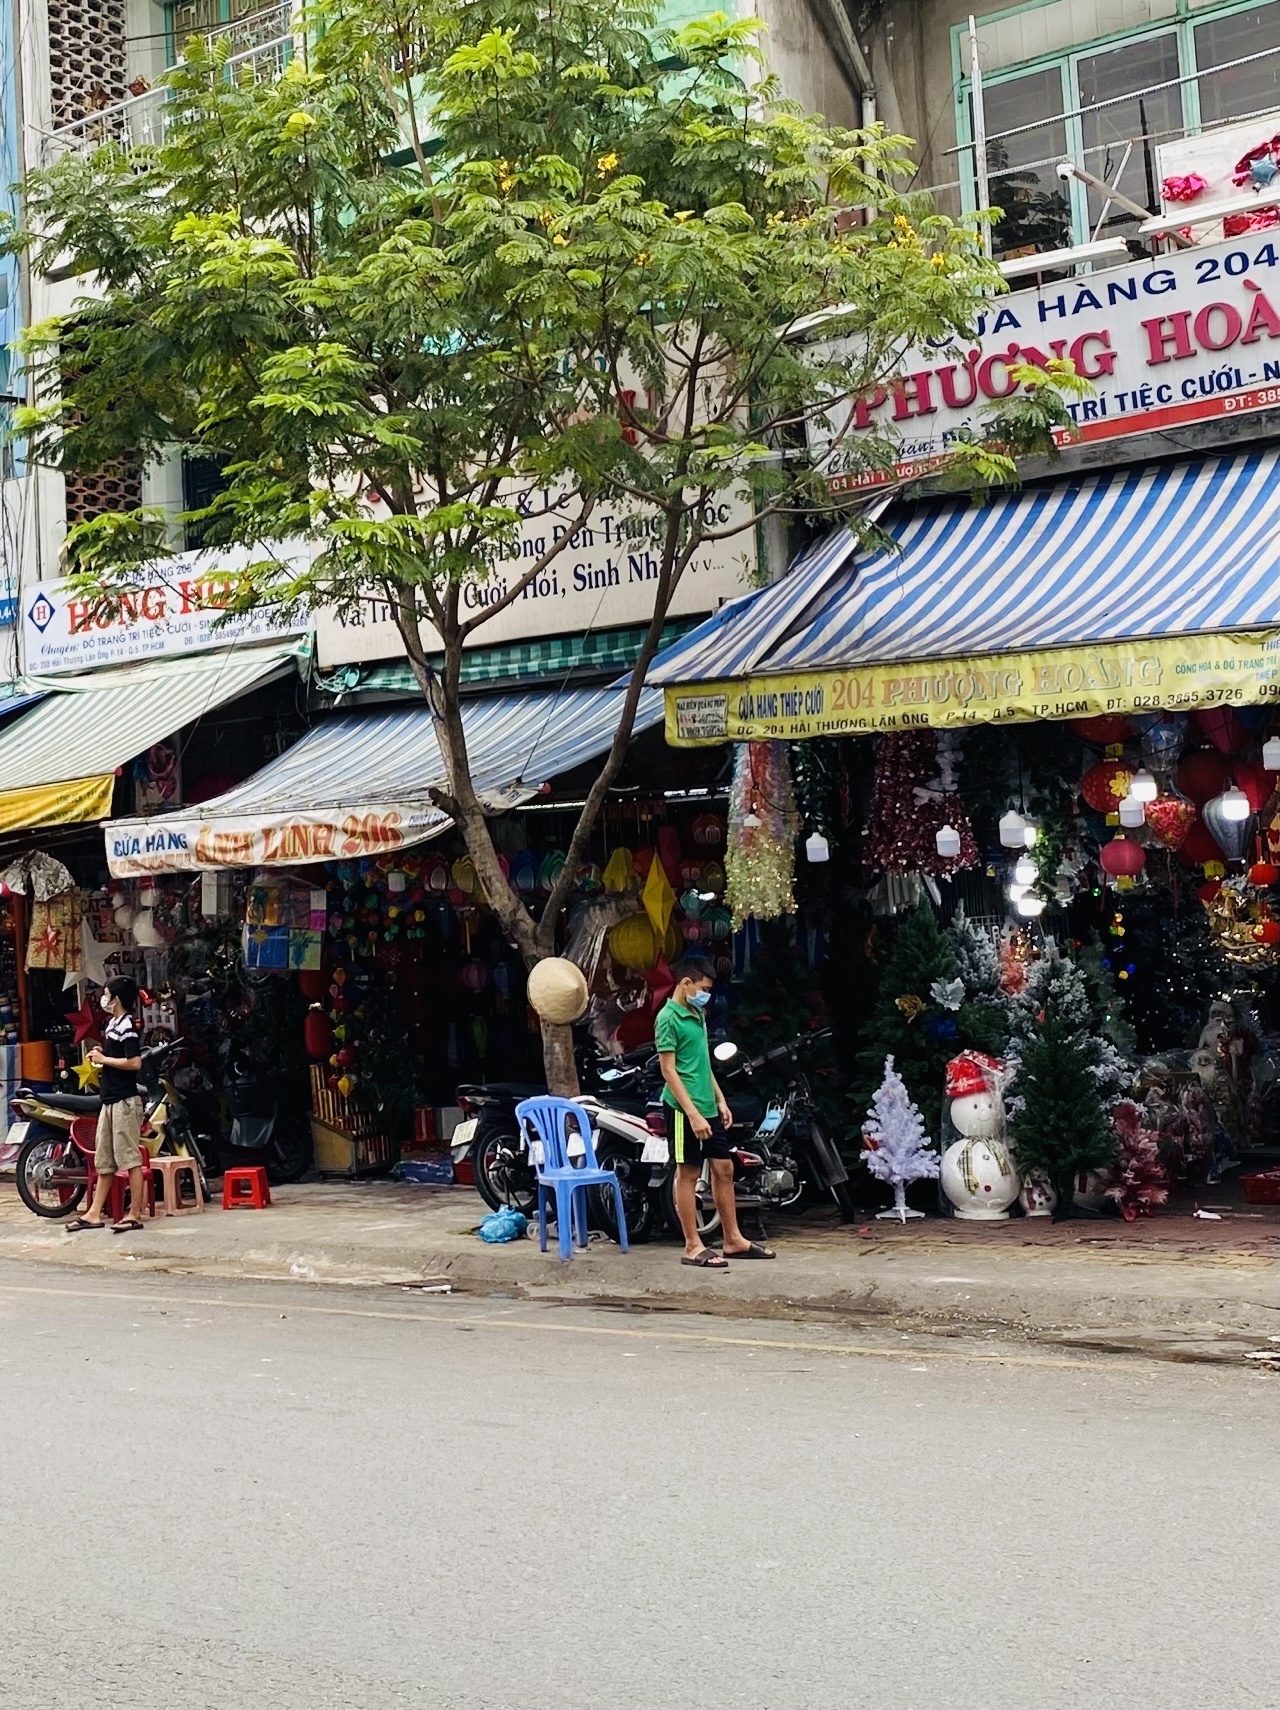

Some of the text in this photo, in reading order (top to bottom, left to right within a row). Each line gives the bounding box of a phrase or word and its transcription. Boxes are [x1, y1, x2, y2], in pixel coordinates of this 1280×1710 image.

[1038, 243, 1280, 322] HÀNG 204
[1114, 382, 1173, 412] TIỆC
[1181, 364, 1242, 400] CƯỚI
[1224, 394, 1253, 412] ĐT:
[573, 557, 621, 592] Sinh
[36, 604, 47, 620] H
[97, 633, 127, 646] TRANG
[831, 676, 875, 712] 204
[881, 669, 1024, 708] PHƯỢNG
[1031, 651, 1164, 696] HOÀNG
[763, 724, 784, 735] 204
[1032, 699, 1089, 717] TP.HCM
[113, 832, 141, 857] CỬA
[145, 829, 188, 853] HÀNG
[260, 822, 338, 862] LINH
[341, 811, 405, 856] 206
